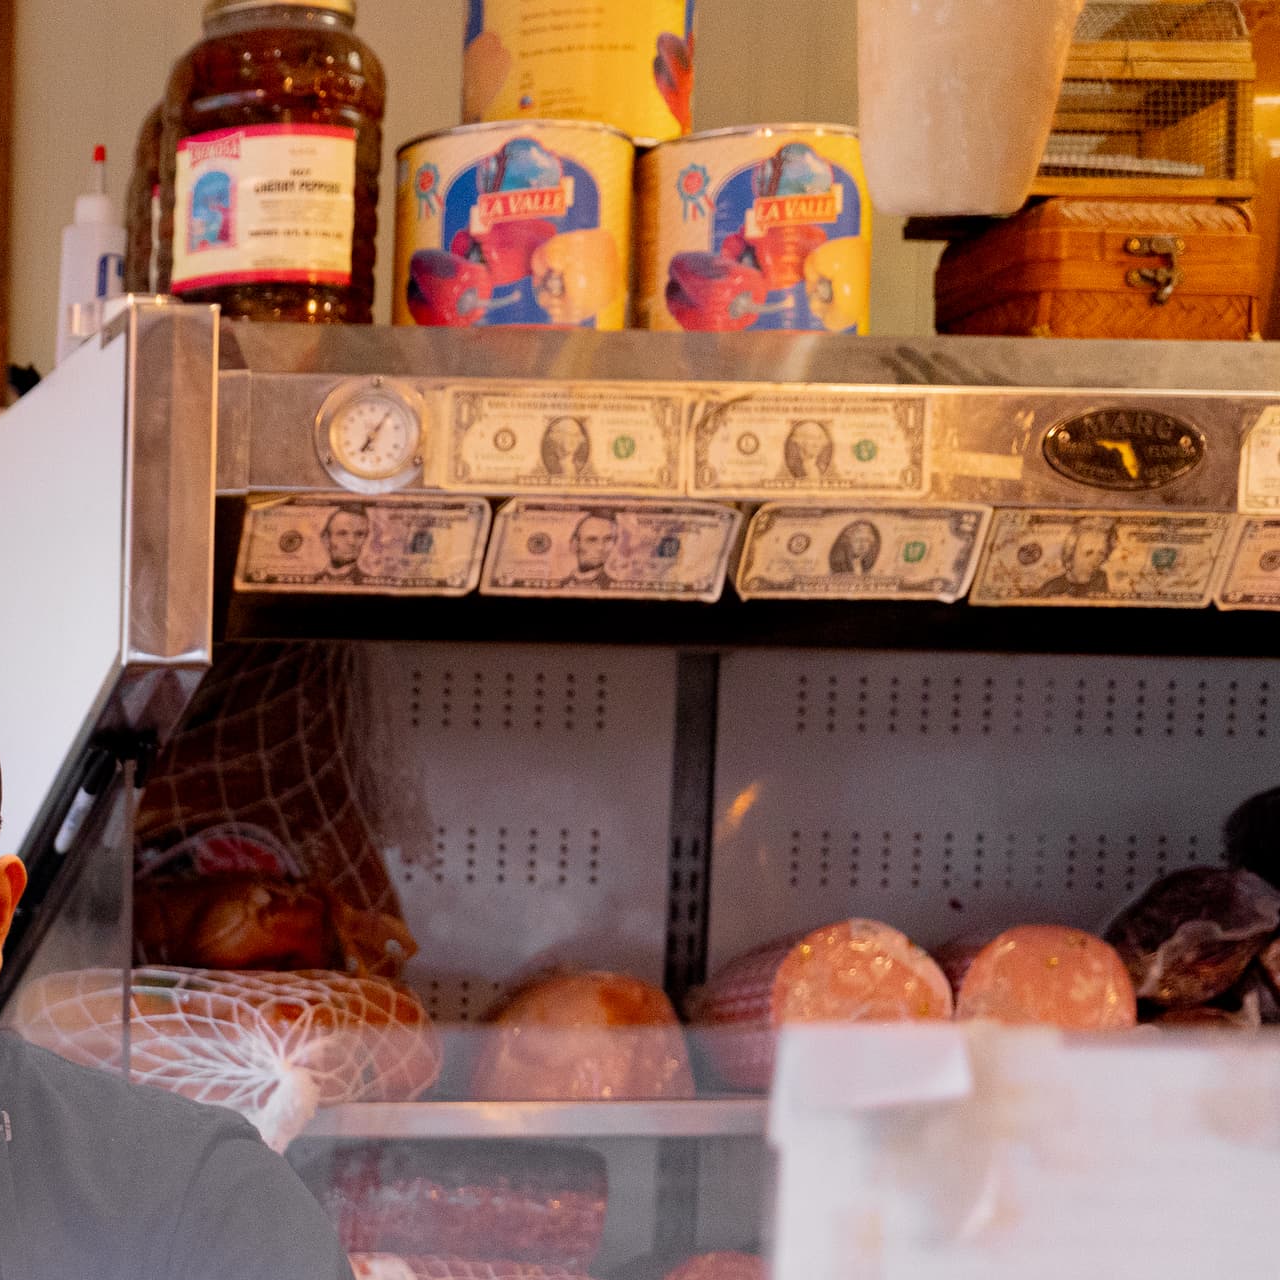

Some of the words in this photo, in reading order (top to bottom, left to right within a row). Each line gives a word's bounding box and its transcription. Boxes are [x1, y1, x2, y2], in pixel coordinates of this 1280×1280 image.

[481, 198, 505, 216] LA
[509, 191, 563, 213] VALLE
[757, 205, 780, 221] LA
[784, 198, 836, 218] VALLE
